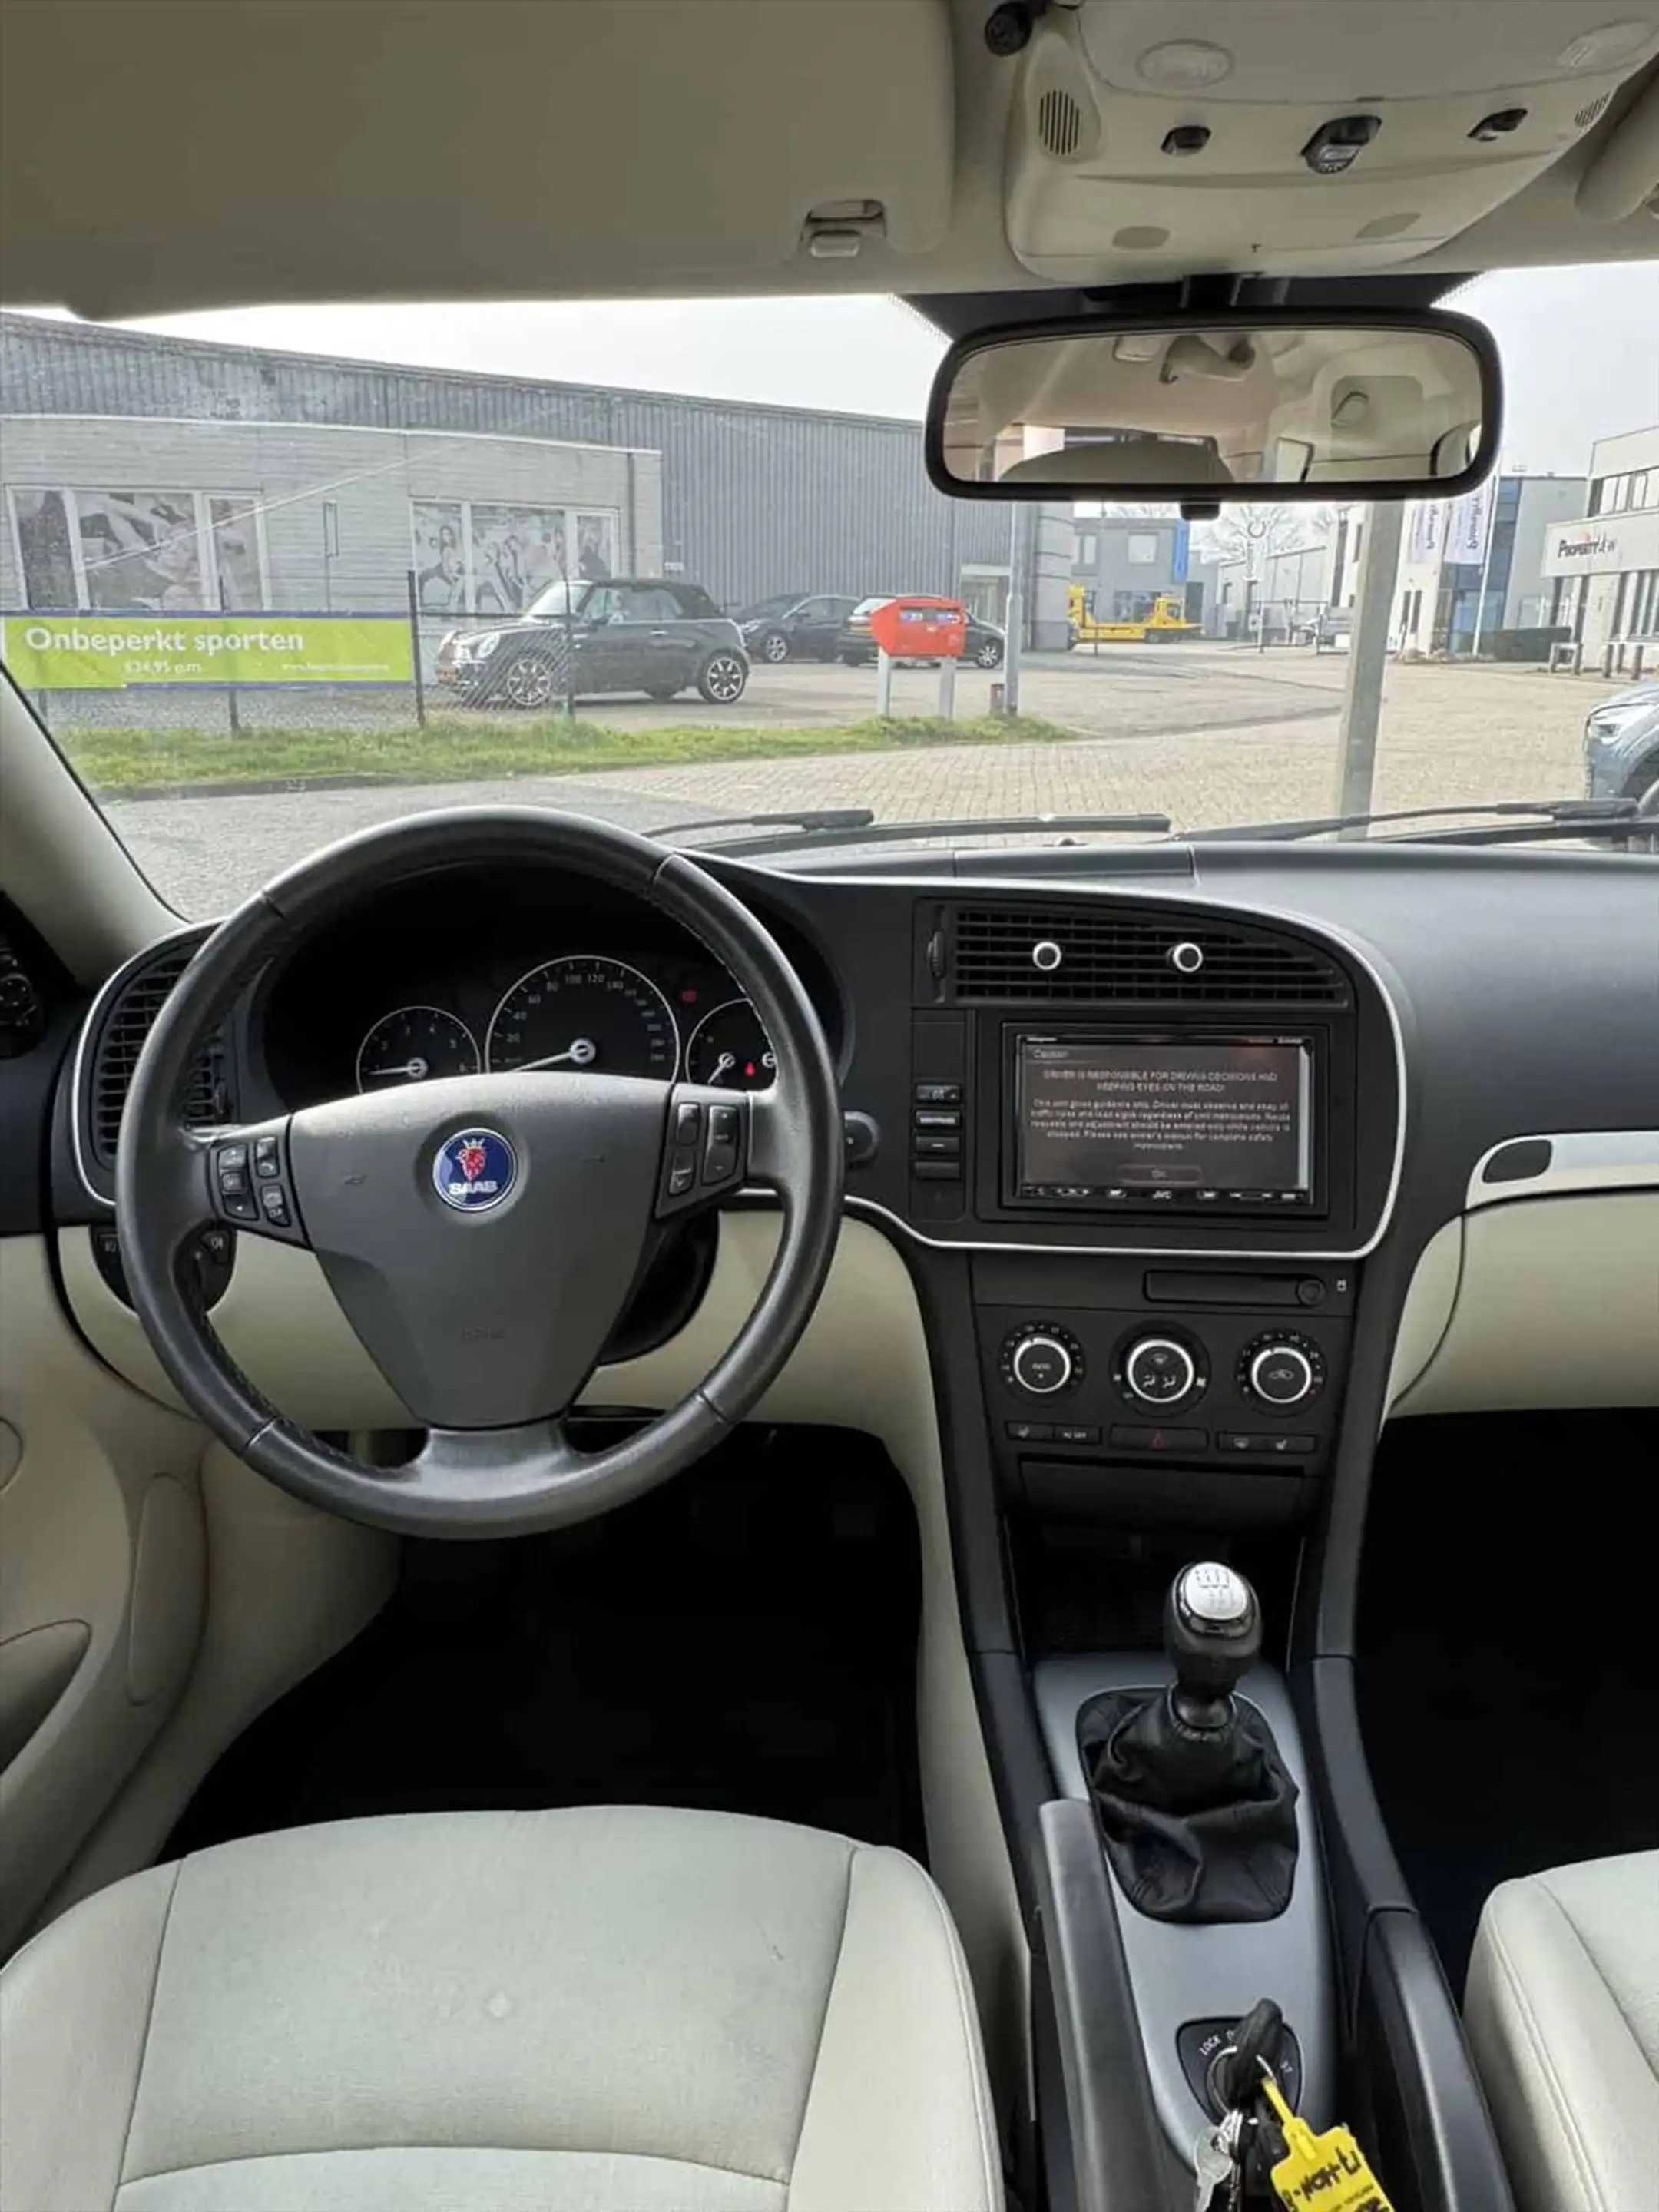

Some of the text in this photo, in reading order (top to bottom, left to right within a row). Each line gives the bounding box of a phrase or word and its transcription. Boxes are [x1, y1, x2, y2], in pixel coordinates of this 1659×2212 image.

[26, 626, 303, 657] Onbeperkt sporten
[449, 1181, 498, 1195] SAAB
[1197, 2033, 1223, 2057] LOCK
